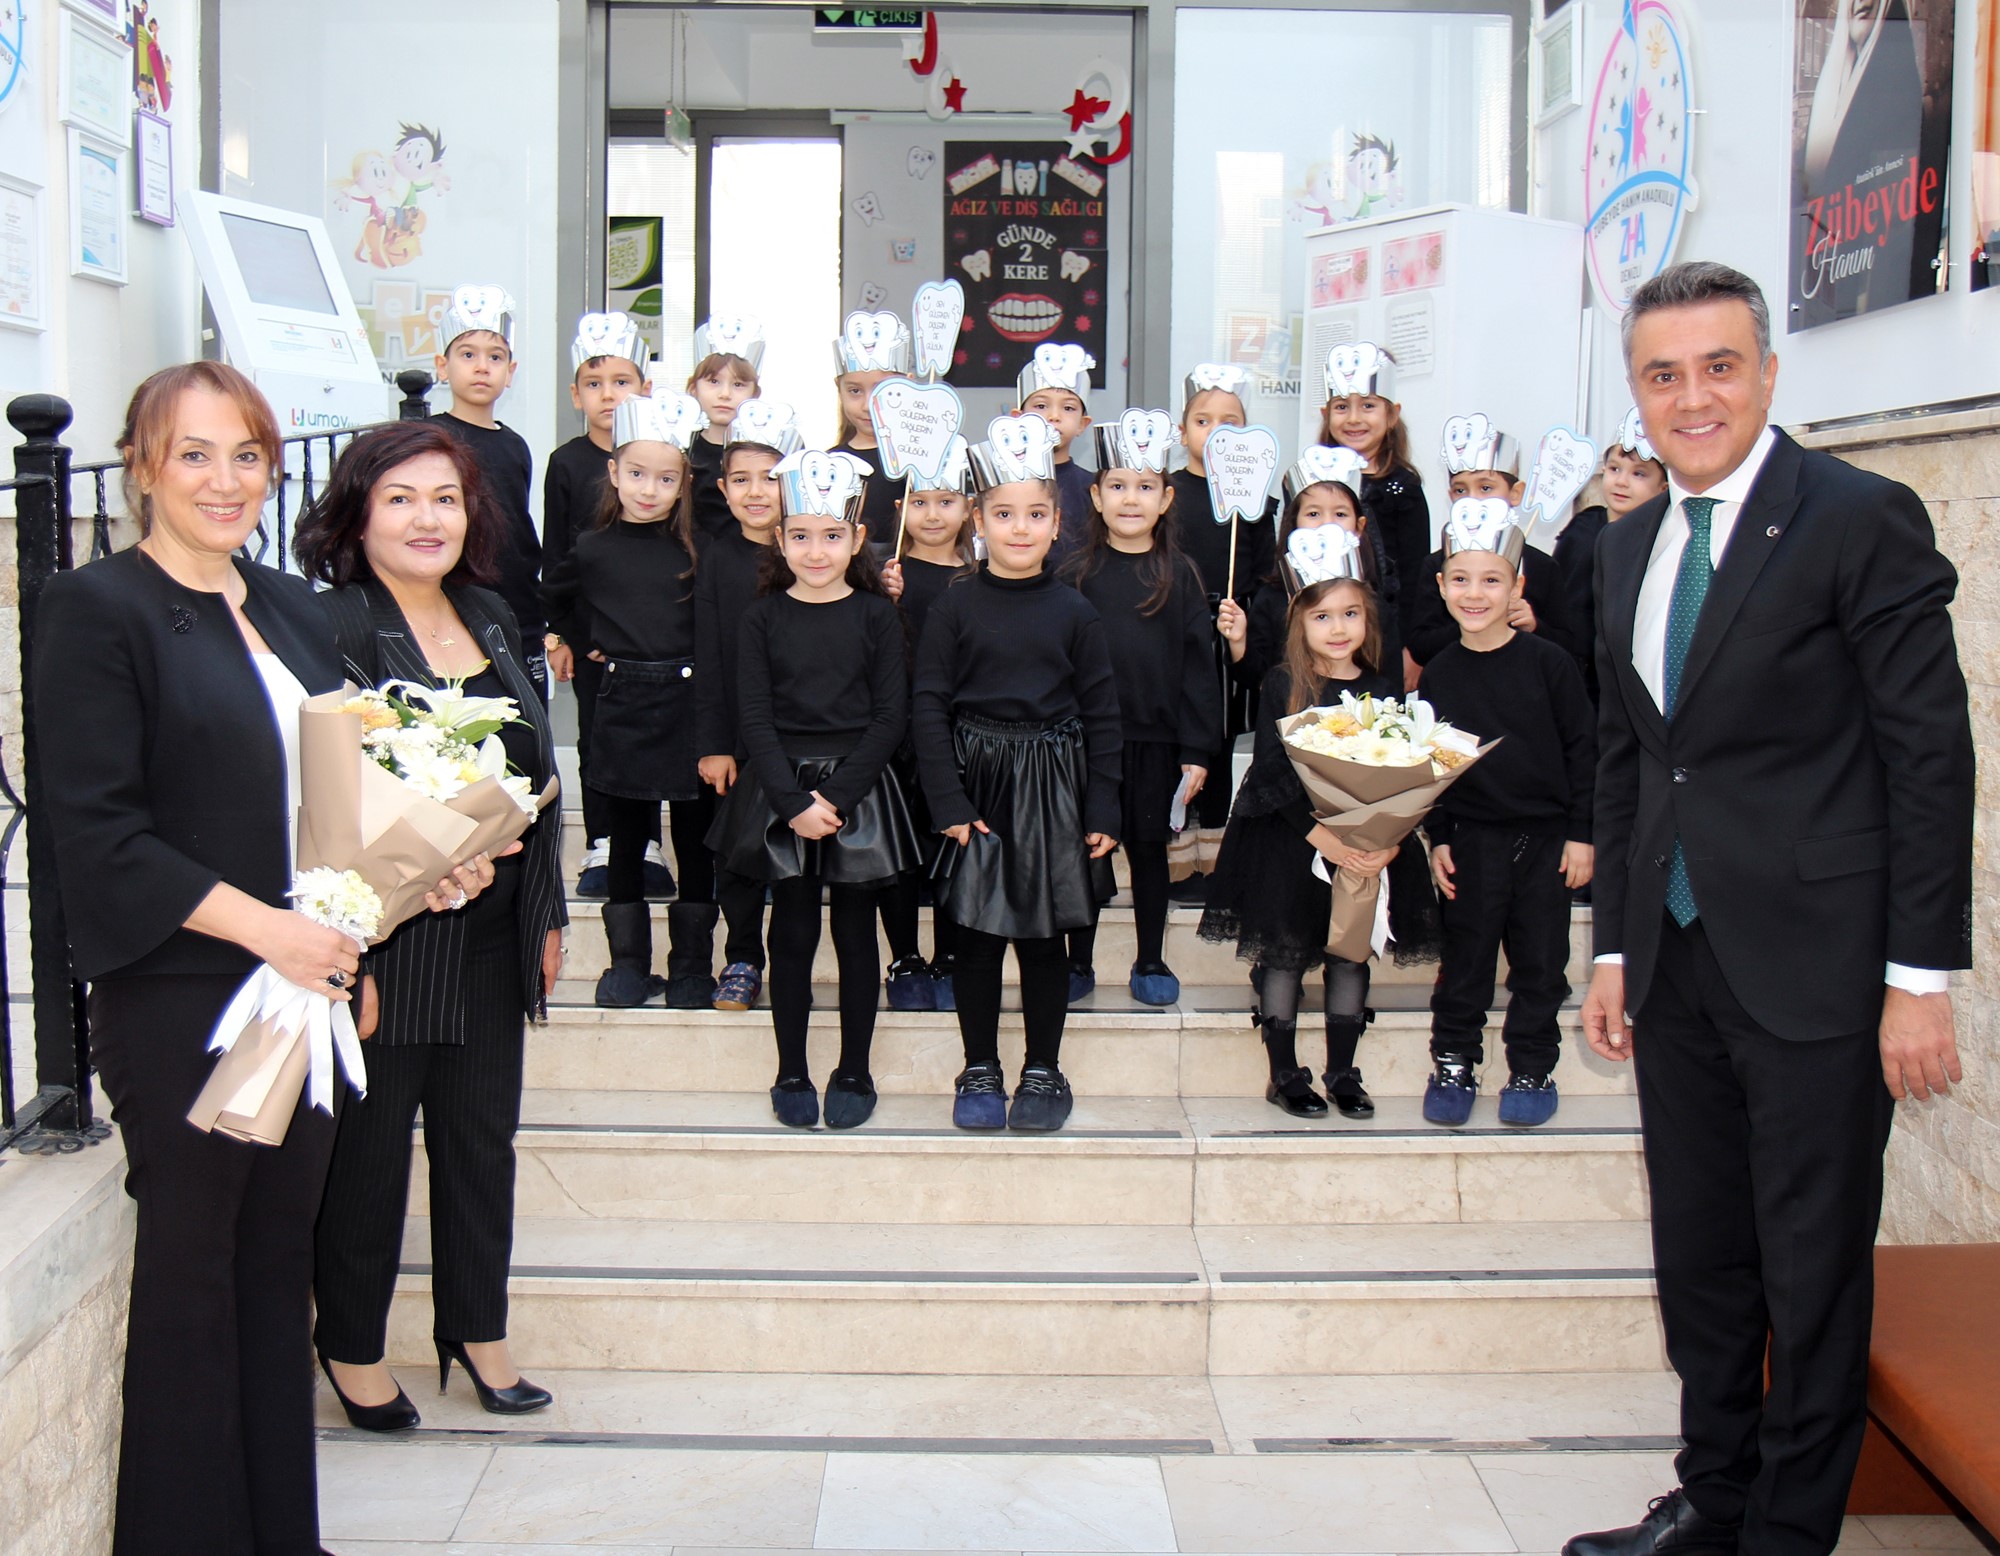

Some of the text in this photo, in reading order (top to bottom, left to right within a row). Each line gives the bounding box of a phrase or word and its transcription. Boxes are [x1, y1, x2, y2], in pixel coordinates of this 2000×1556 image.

[880, 11, 917, 24] ÇIKIŞ
[1641, 188, 1675, 208] ANAOKULU
[1805, 156, 1939, 257] Zübeyde
[951, 199, 988, 216] AĞIZ
[991, 202, 1012, 216] VE
[996, 224, 1058, 250] GÜNDE
[1619, 211, 1647, 264] ZHA
[1019, 243, 1033, 263] 2
[1003, 264, 1049, 280] KERE
[1801, 229, 1876, 300] Hanım
[1261, 380, 1301, 395] HANI
[909, 434, 920, 445] DE
[1233, 477, 1243, 486] DE
